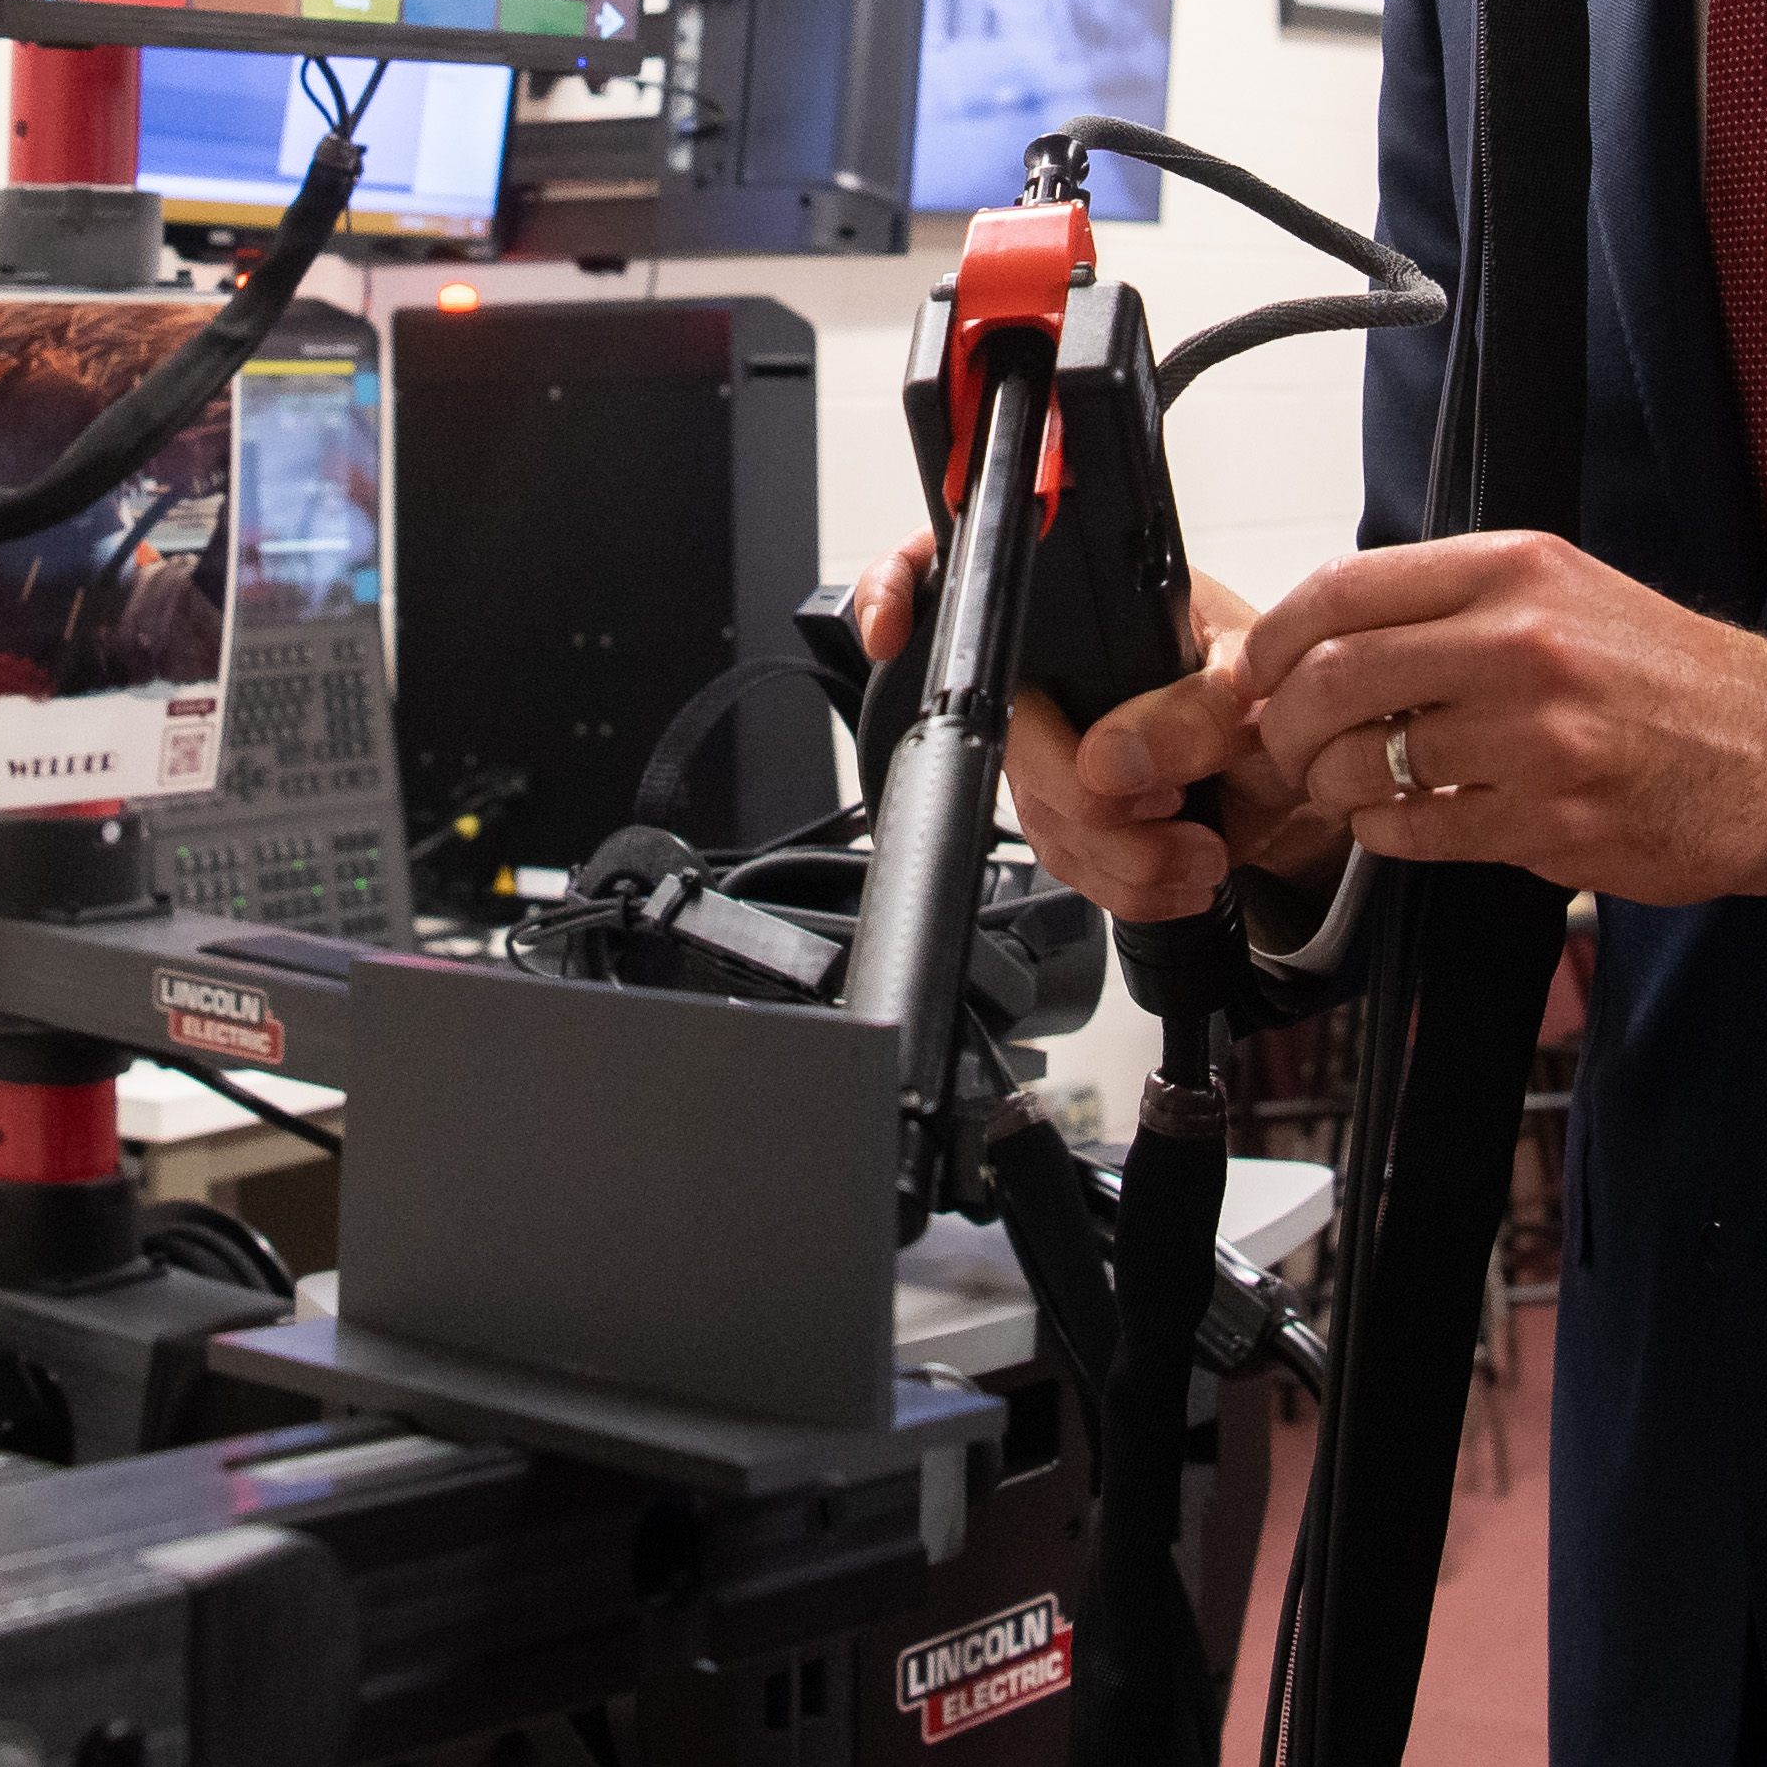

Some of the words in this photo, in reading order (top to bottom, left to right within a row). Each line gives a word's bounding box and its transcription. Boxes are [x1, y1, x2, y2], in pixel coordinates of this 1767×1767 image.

[159, 977, 261, 1024] LINCOLN
[182, 1013, 271, 1054] ELECTRIC
[907, 1605, 1049, 1699] LINCOLN
[941, 1648, 1065, 1725] ELECTRIC
